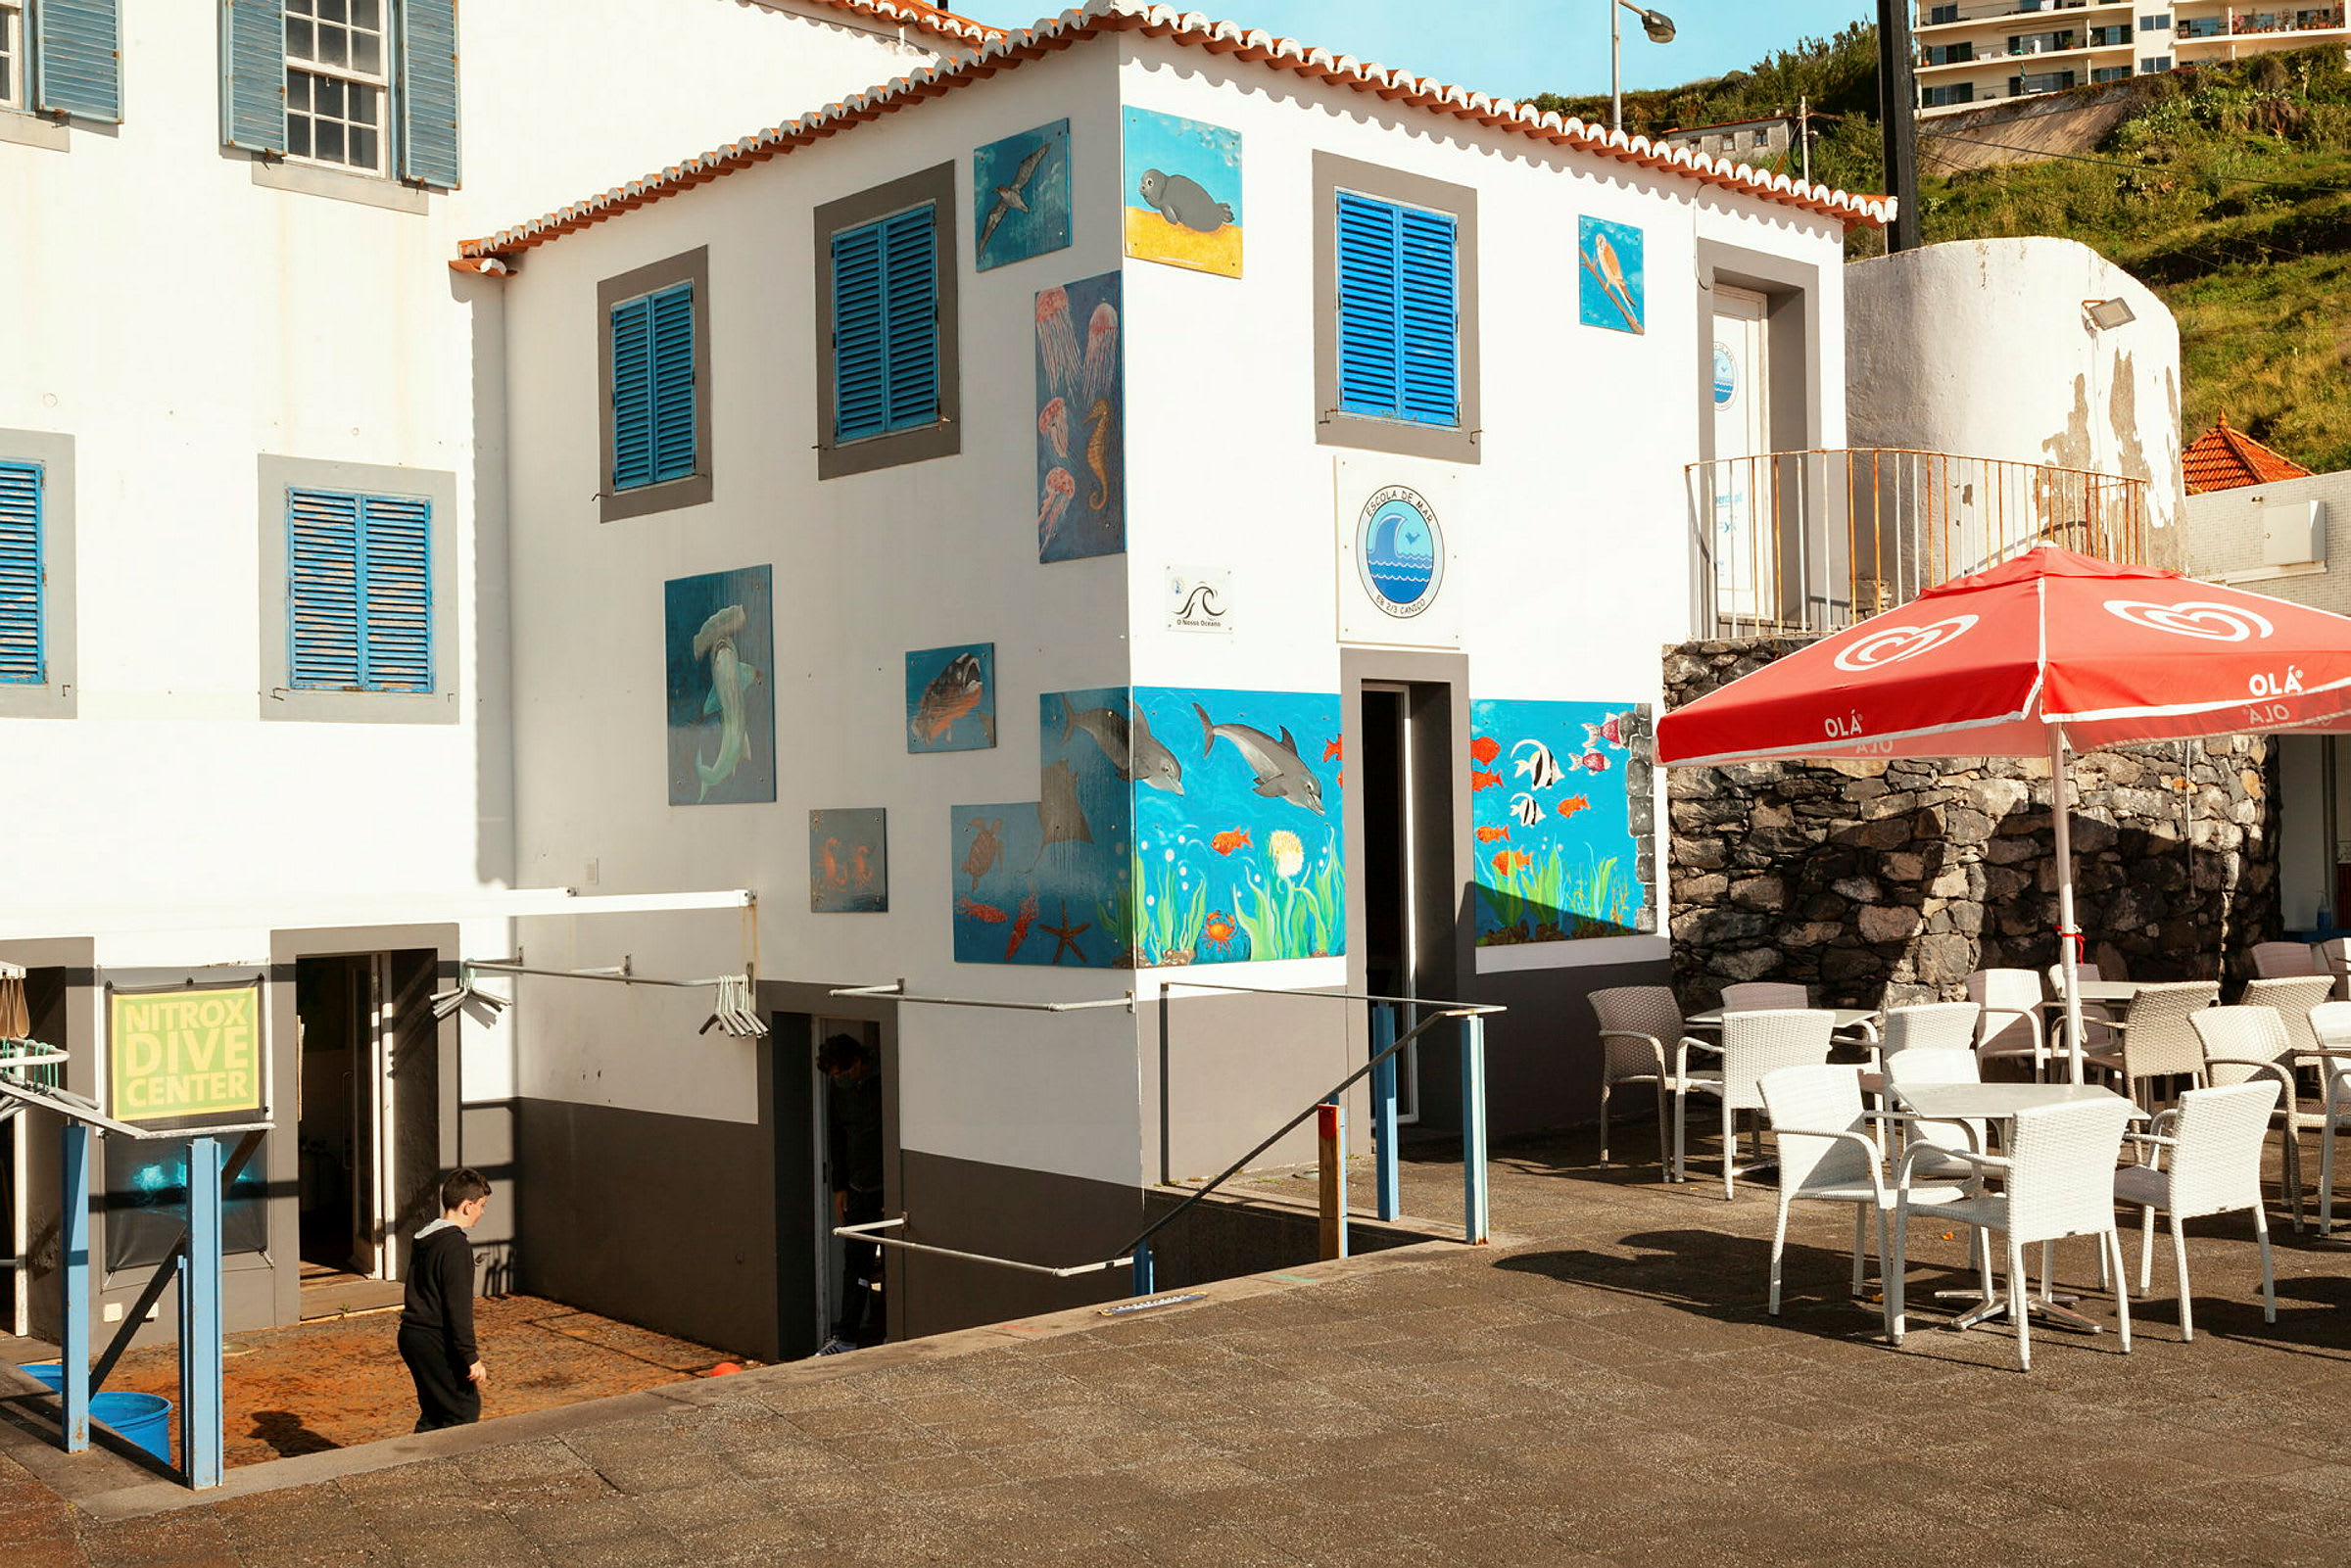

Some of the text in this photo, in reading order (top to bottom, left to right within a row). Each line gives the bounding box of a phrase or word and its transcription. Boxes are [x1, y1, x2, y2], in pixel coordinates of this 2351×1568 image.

[1366, 490, 1433, 523] ESCOLA DE MAR
[1386, 602, 1398, 613] 2/3
[2249, 665, 2303, 696] OLÁ
[1824, 709, 1862, 737] OLÁ
[124, 998, 248, 1032] NITROX
[125, 1025, 249, 1077] DIVE
[126, 1070, 249, 1108] CENTER
